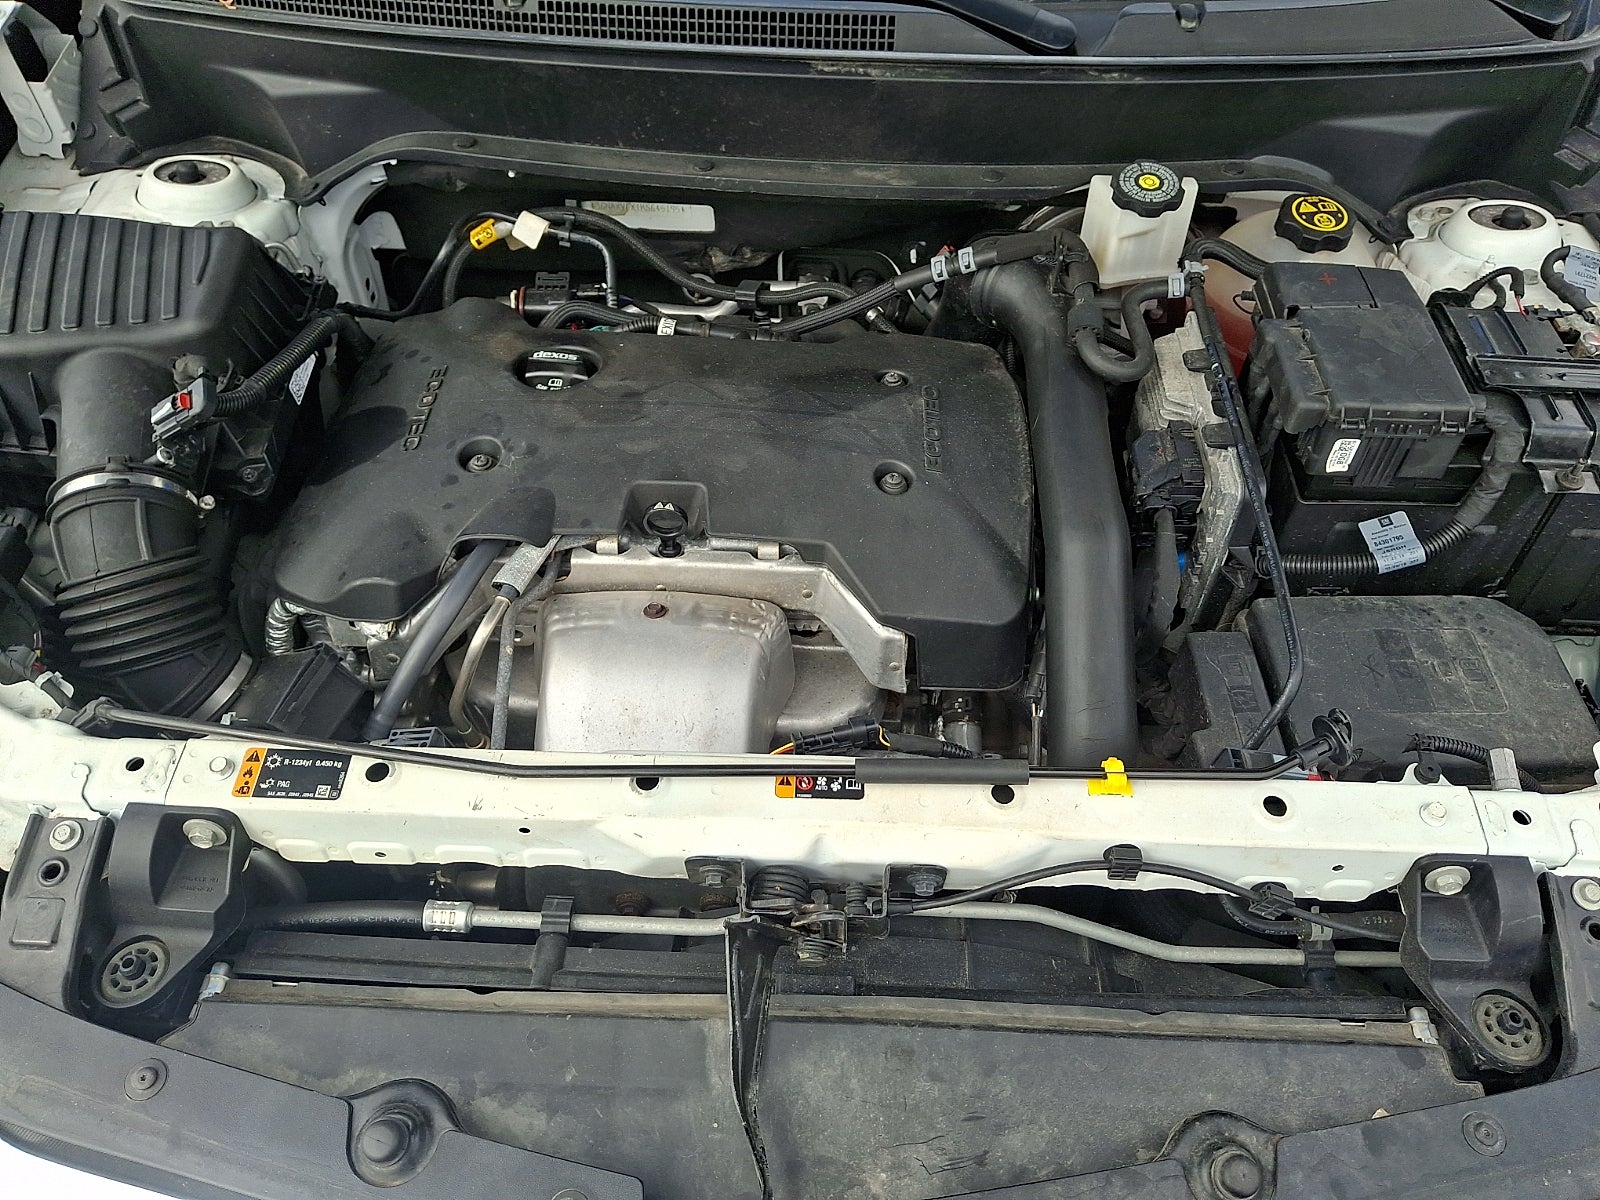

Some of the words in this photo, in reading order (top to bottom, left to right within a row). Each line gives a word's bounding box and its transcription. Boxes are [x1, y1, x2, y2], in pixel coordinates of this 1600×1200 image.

[533, 351, 579, 361] dexos
[401, 364, 449, 452] ECOTEC
[922, 385, 943, 473] ECOTEC
[283, 758, 313, 767] R-1234yf
[333, 760, 343, 768] kg
[276, 780, 291, 788] PAG
